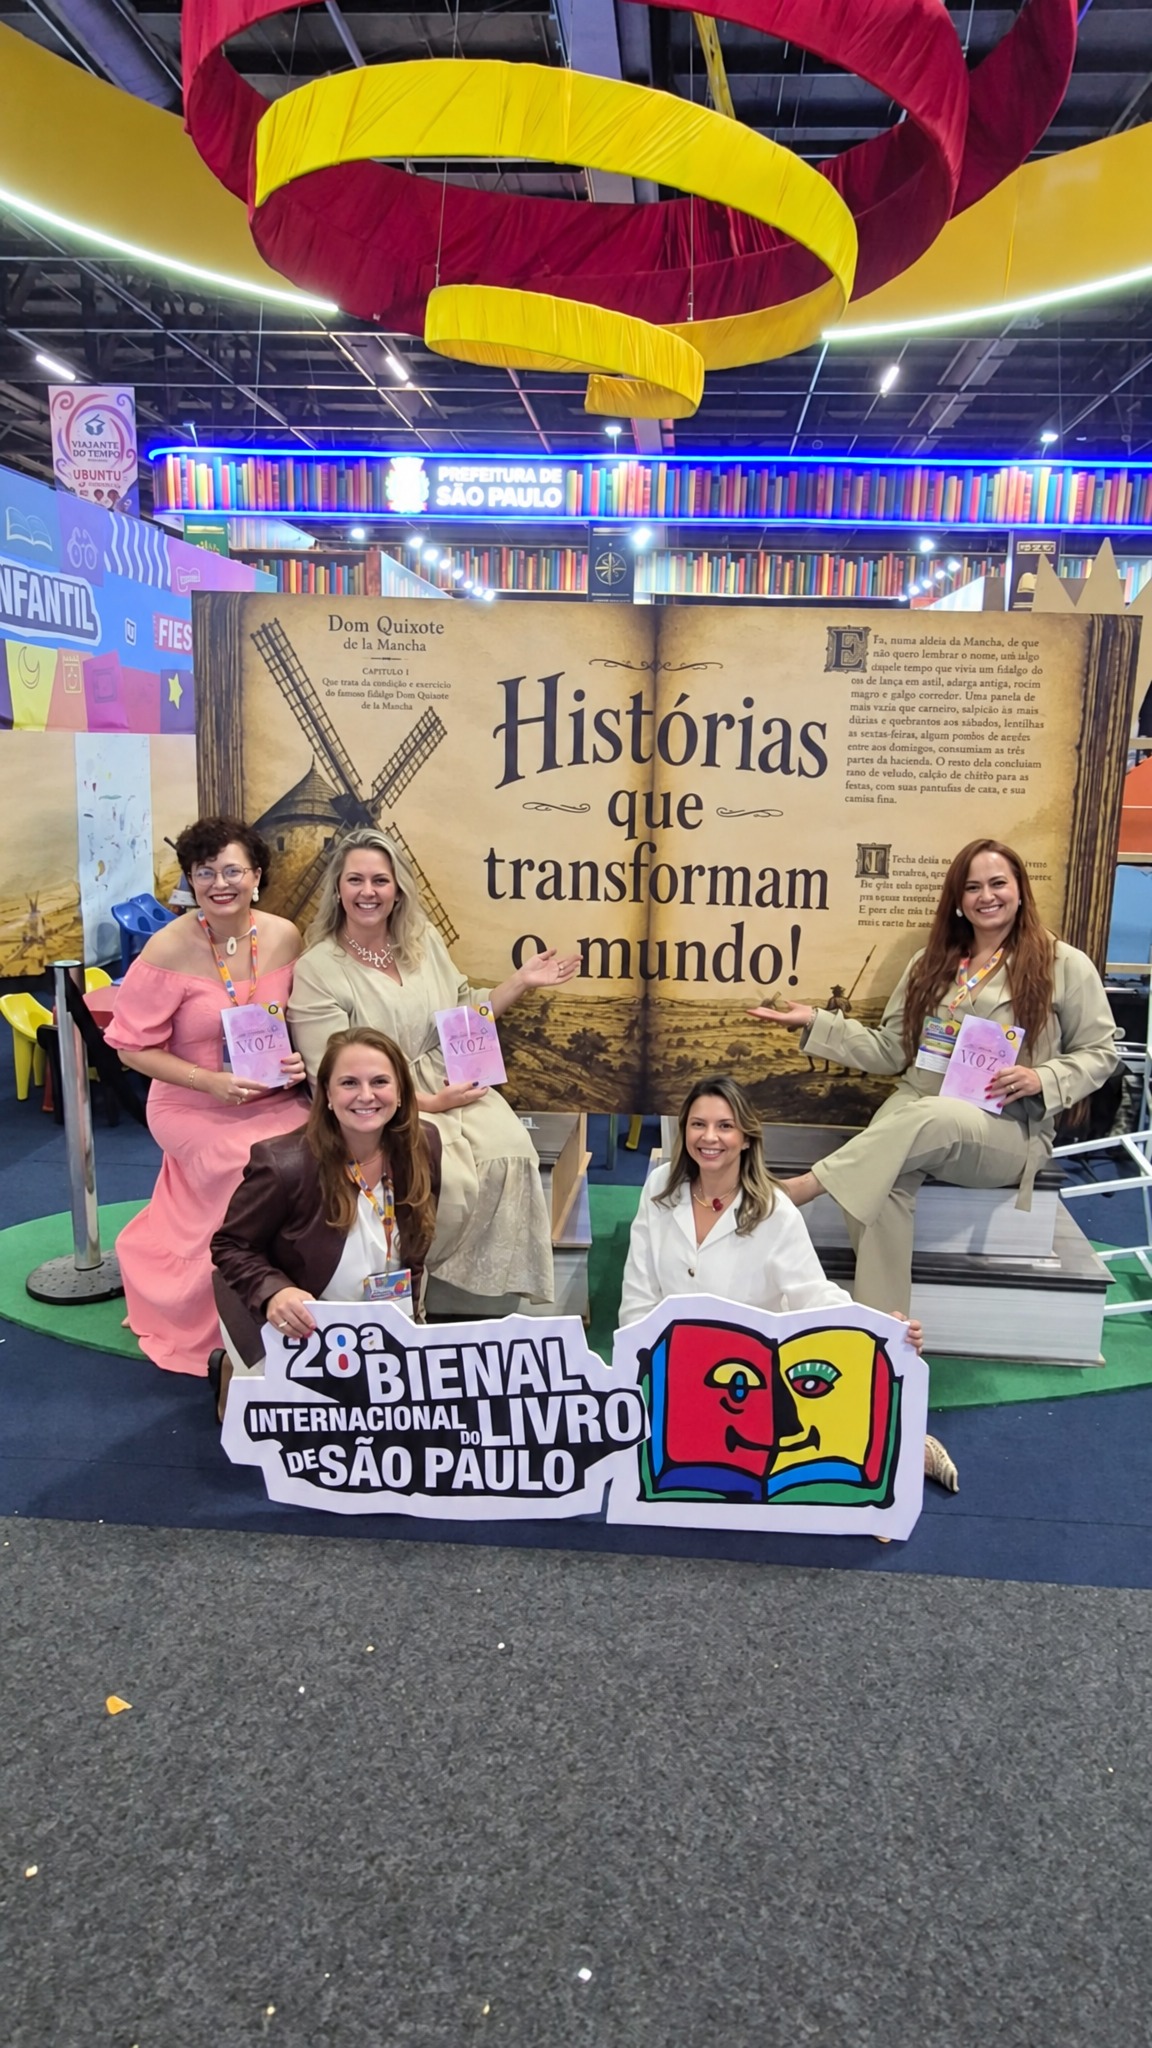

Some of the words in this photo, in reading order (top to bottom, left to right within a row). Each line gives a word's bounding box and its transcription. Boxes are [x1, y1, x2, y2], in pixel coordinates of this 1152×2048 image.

[71, 440, 119, 449] VIAJANTE
[88, 450, 120, 458] TEMPO
[73, 469, 121, 481] UBUNTU
[438, 466, 537, 483] PREFEITURA
[539, 468, 563, 484] DE
[436, 483, 484, 506] SÃO
[488, 486, 563, 508] PAULO
[328, 614, 369, 632] Dom
[377, 615, 444, 636] Quixote
[343, 637, 358, 649] de
[362, 638, 373, 650] la
[377, 638, 427, 651] Mancha
[890, 637, 917, 645] numa
[919, 636, 946, 645] aldeia
[949, 636, 961, 646] da
[963, 636, 1004, 647] Mancha,
[1007, 637, 1019, 647] de
[1021, 640, 1039, 649] que
[892, 651, 919, 660] quero
[922, 649, 959, 659] lembrar
[970, 653, 998, 661] nome,
[406, 668, 409, 676] I
[904, 664, 932, 675] tempo
[935, 666, 952, 675] que
[955, 664, 977, 673] vivia
[1031, 665, 1043, 675] do
[322, 678, 339, 687] Que
[341, 679, 359, 687] trata
[361, 678, 371, 687] da
[373, 678, 407, 689] condição
[866, 676, 877, 685] de
[879, 676, 903, 687] lança
[946, 677, 977, 690] adarga
[979, 678, 1011, 690] antiga,
[1013, 679, 1041, 688] rocim
[325, 689, 335, 697] do
[338, 689, 365, 697] famoso
[396, 691, 415, 699] Dom
[851, 691, 880, 700] magro
[891, 689, 916, 701] galgo
[919, 690, 961, 700] corredor.
[965, 691, 988, 700] Uma
[990, 692, 1021, 702] panela
[1024, 692, 1036, 701] de
[361, 701, 371, 709] de
[373, 701, 380, 709] la
[382, 702, 413, 710] Mancha
[850, 702, 871, 711] mais
[899, 705, 916, 714] que
[918, 704, 959, 714] carneiro,
[1016, 706, 1039, 714] mais
[889, 716, 941, 727] quebrantos
[1004, 718, 1044, 728] lentilhas
[493, 671, 828, 789] Histórias
[920, 730, 949, 741] algum
[988, 732, 999, 741] de
[938, 745, 992, 754] consumiam
[847, 756, 874, 766] partes
[876, 755, 888, 764] da
[935, 757, 945, 766] O
[948, 759, 970, 767] resto
[973, 758, 992, 767] dela
[868, 767, 880, 777] de
[882, 768, 916, 779] veludo,
[950, 770, 961, 780] de
[996, 773, 1016, 783] para
[845, 780, 873, 791] festas,
[964, 783, 975, 793] de
[845, 794, 874, 802] camisa
[877, 794, 897, 803] fina.
[607, 789, 703, 841] que
[483, 841, 830, 910] transformam
[576, 920, 802, 987] mundo!
[364, 1338, 583, 1404] BIENAL
[249, 1404, 467, 1433] INTERNACIONAL
[460, 1430, 480, 1446] DO
[476, 1391, 643, 1447] LIVRO
[286, 1449, 319, 1474] DE
[318, 1435, 413, 1488] SÃO
[424, 1448, 576, 1492] PAULO
